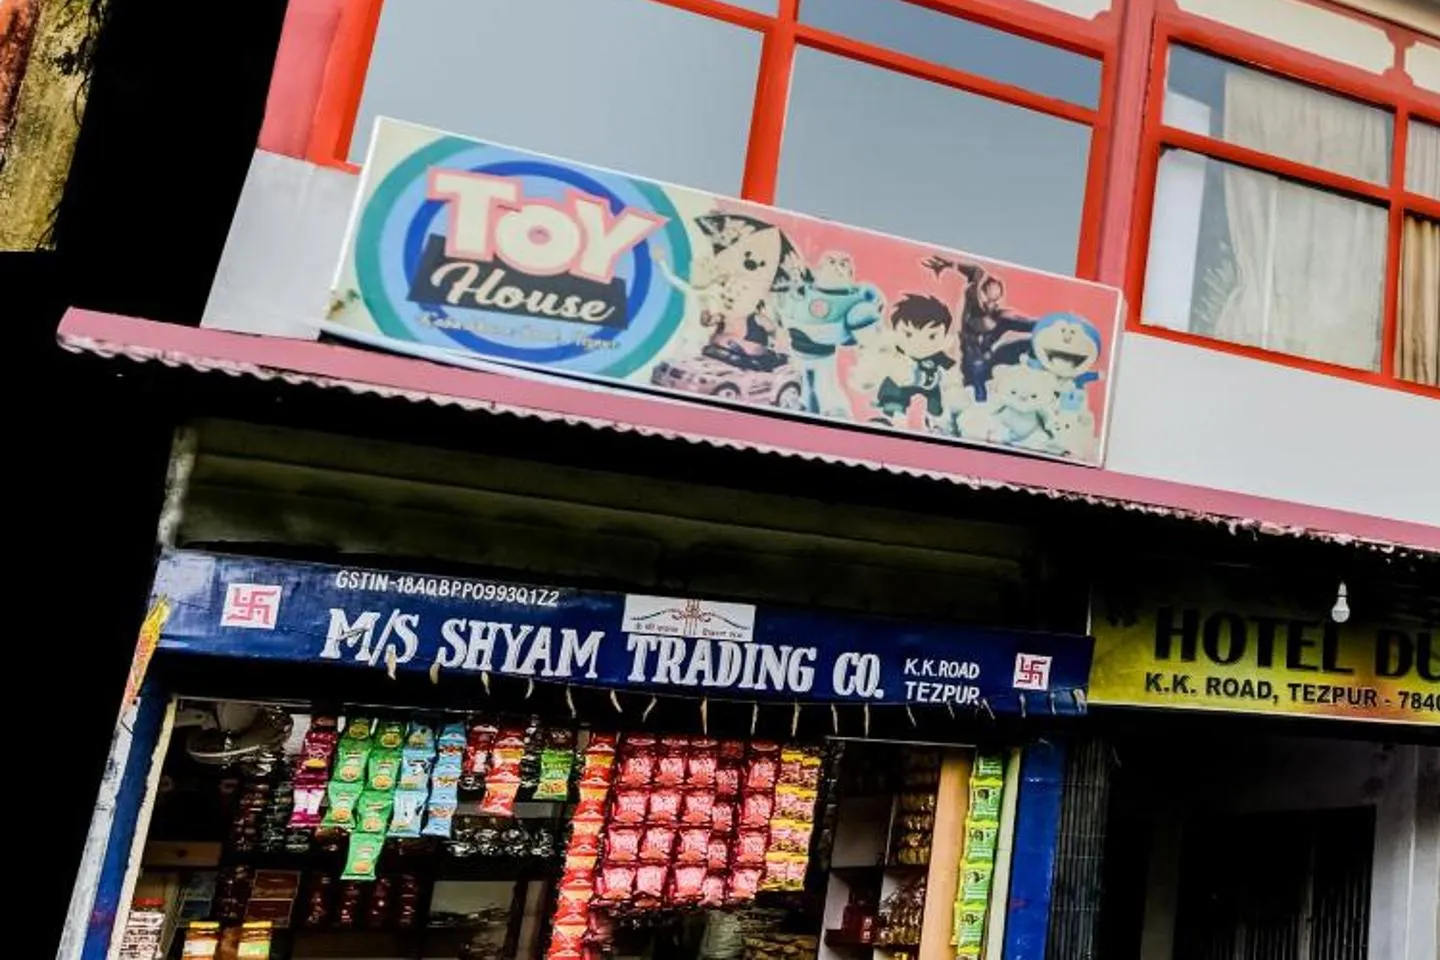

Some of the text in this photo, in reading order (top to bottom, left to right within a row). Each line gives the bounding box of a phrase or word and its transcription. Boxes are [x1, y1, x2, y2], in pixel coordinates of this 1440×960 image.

[427, 165, 670, 284] TOY
[430, 261, 615, 321] House
[320, 608, 885, 699] M/S SHYAM TRADING CO.
[1154, 606, 1353, 674] HOTEL
[1145, 671, 1197, 695] K.K.
[1206, 677, 1278, 704] ROAD,
[1287, 683, 1377, 708] TEZPUR
